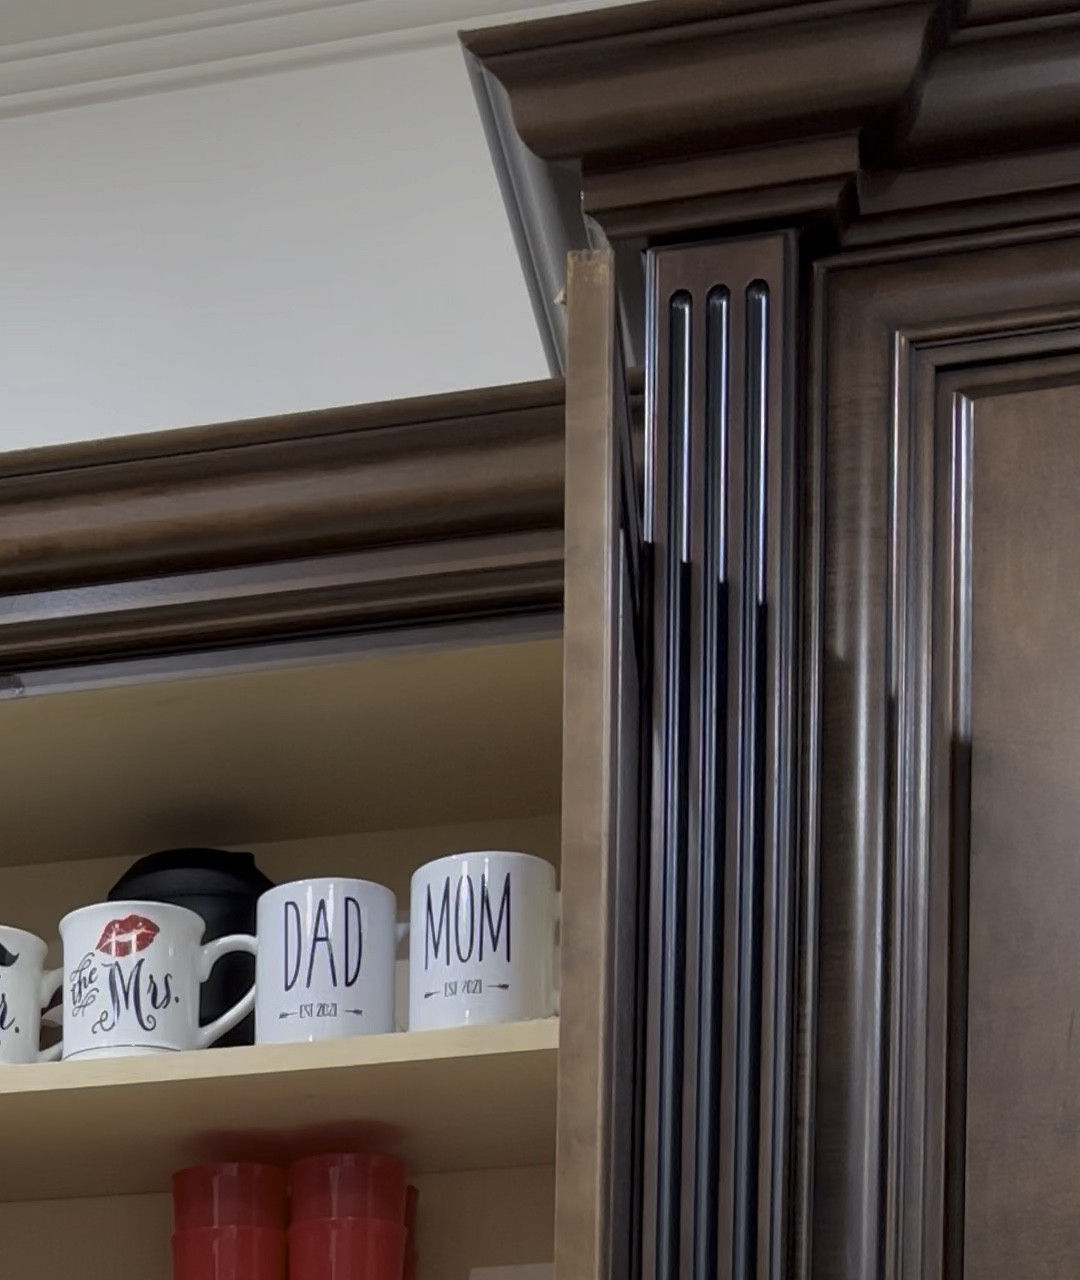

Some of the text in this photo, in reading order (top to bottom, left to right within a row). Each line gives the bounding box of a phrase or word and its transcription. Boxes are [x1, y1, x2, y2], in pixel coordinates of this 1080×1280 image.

[284, 895, 363, 992] DAD
[424, 872, 511, 971] MOM
[70, 951, 180, 1035] the Mrs.
